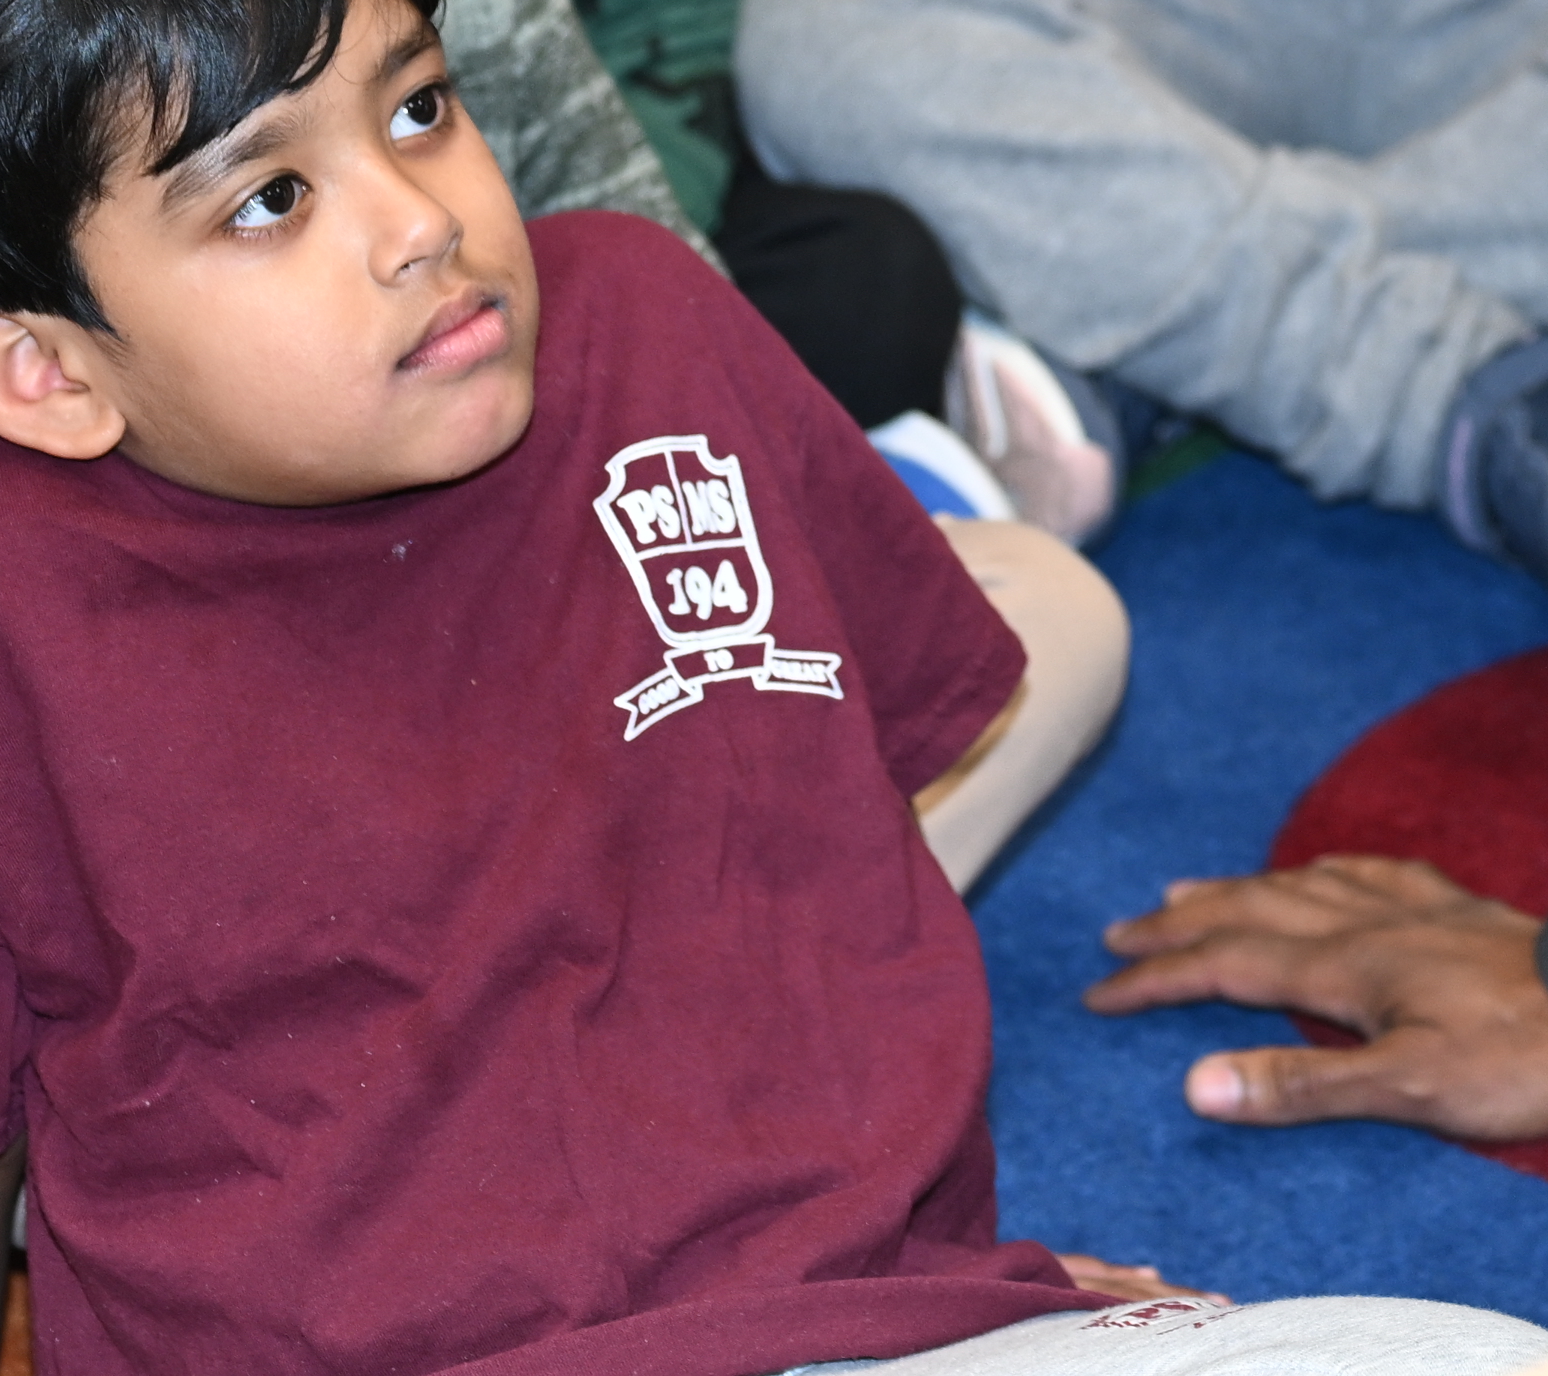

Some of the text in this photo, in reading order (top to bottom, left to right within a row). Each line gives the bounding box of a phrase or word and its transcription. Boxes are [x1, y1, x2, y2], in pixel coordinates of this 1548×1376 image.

[616, 478, 738, 544] PS MS
[666, 559, 749, 621] 194
